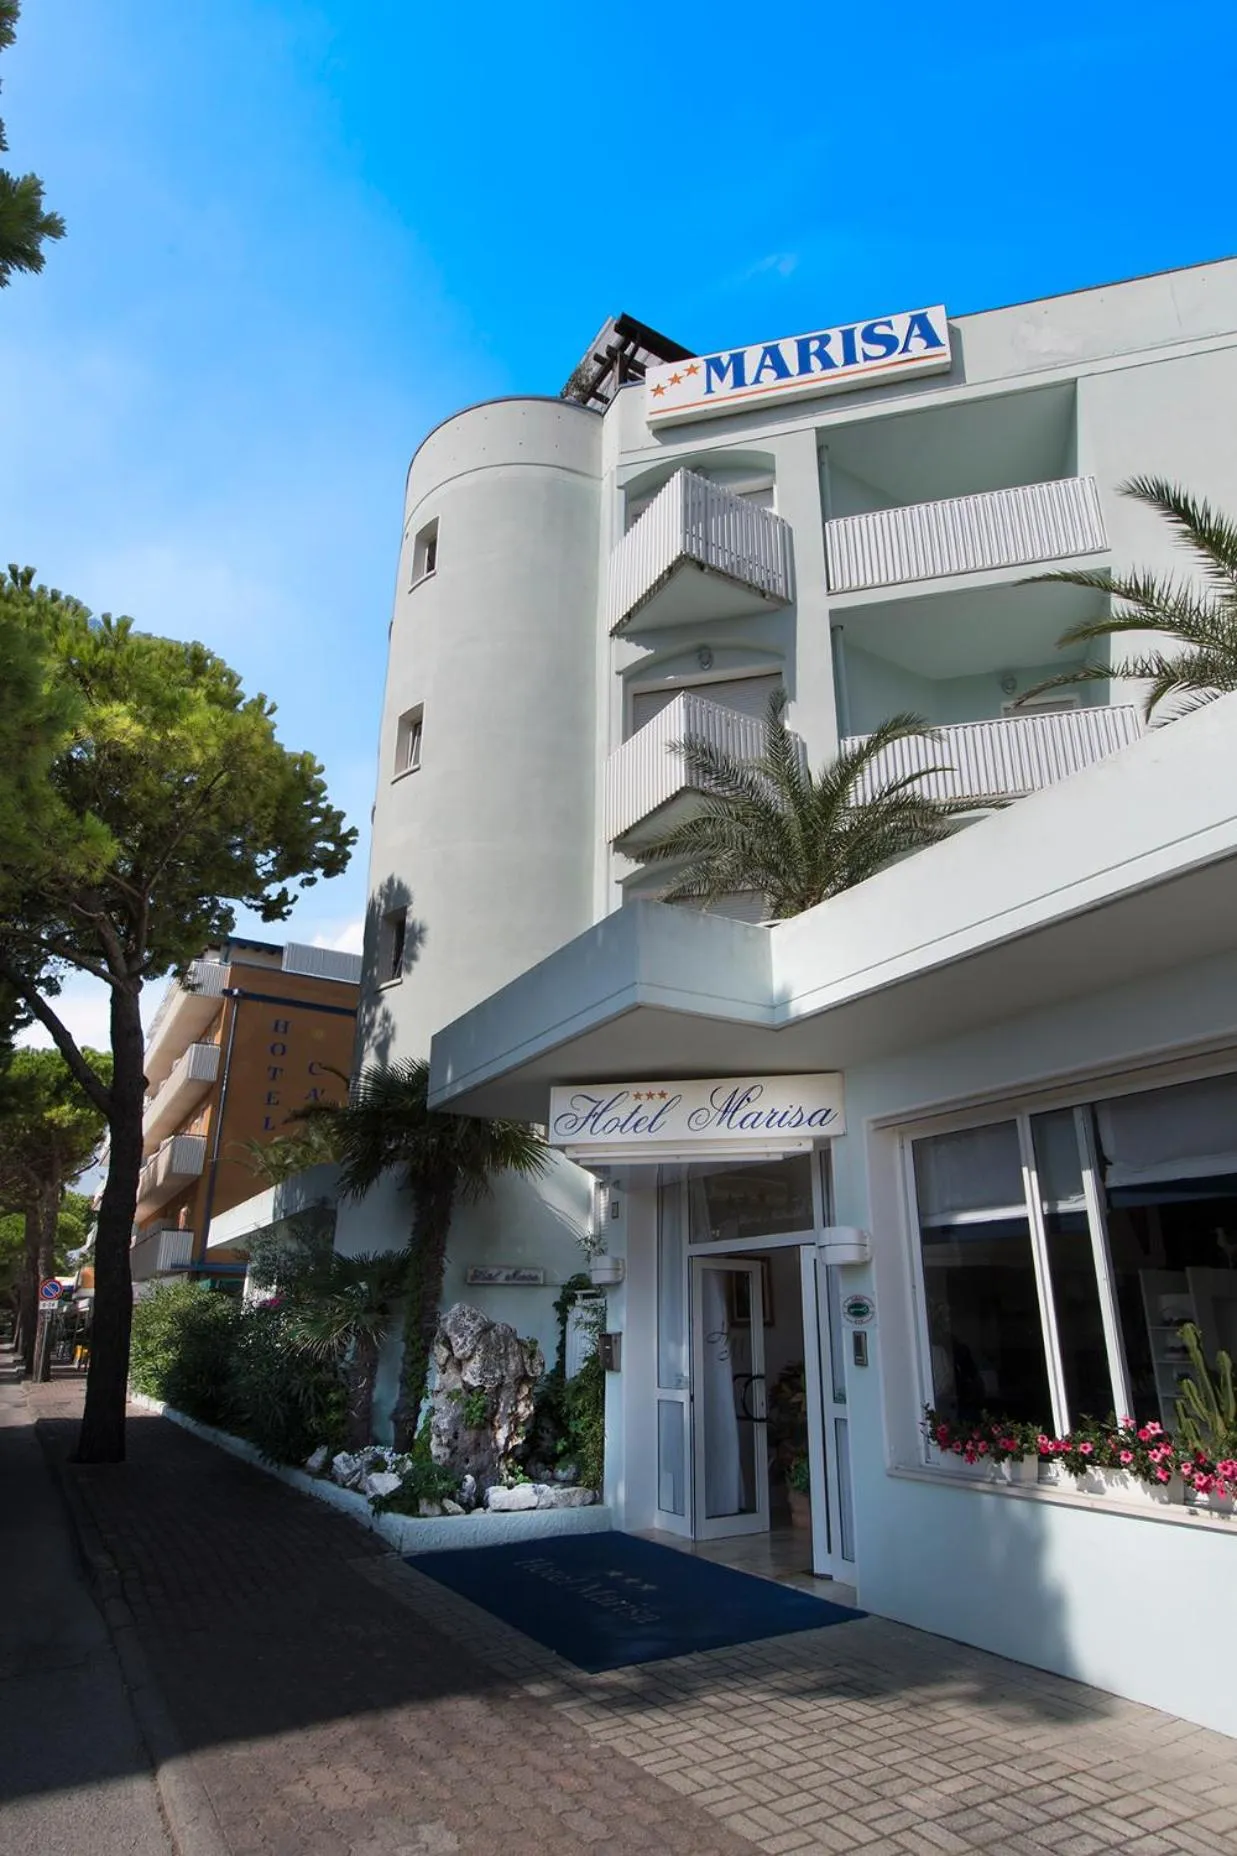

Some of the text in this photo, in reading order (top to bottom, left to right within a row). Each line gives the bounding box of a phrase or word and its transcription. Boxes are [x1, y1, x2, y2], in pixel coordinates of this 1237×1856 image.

[703, 312, 945, 395] MARISA
[263, 1019, 291, 1131] HOTEL
[553, 1084, 839, 1137] Hotel Marisa
